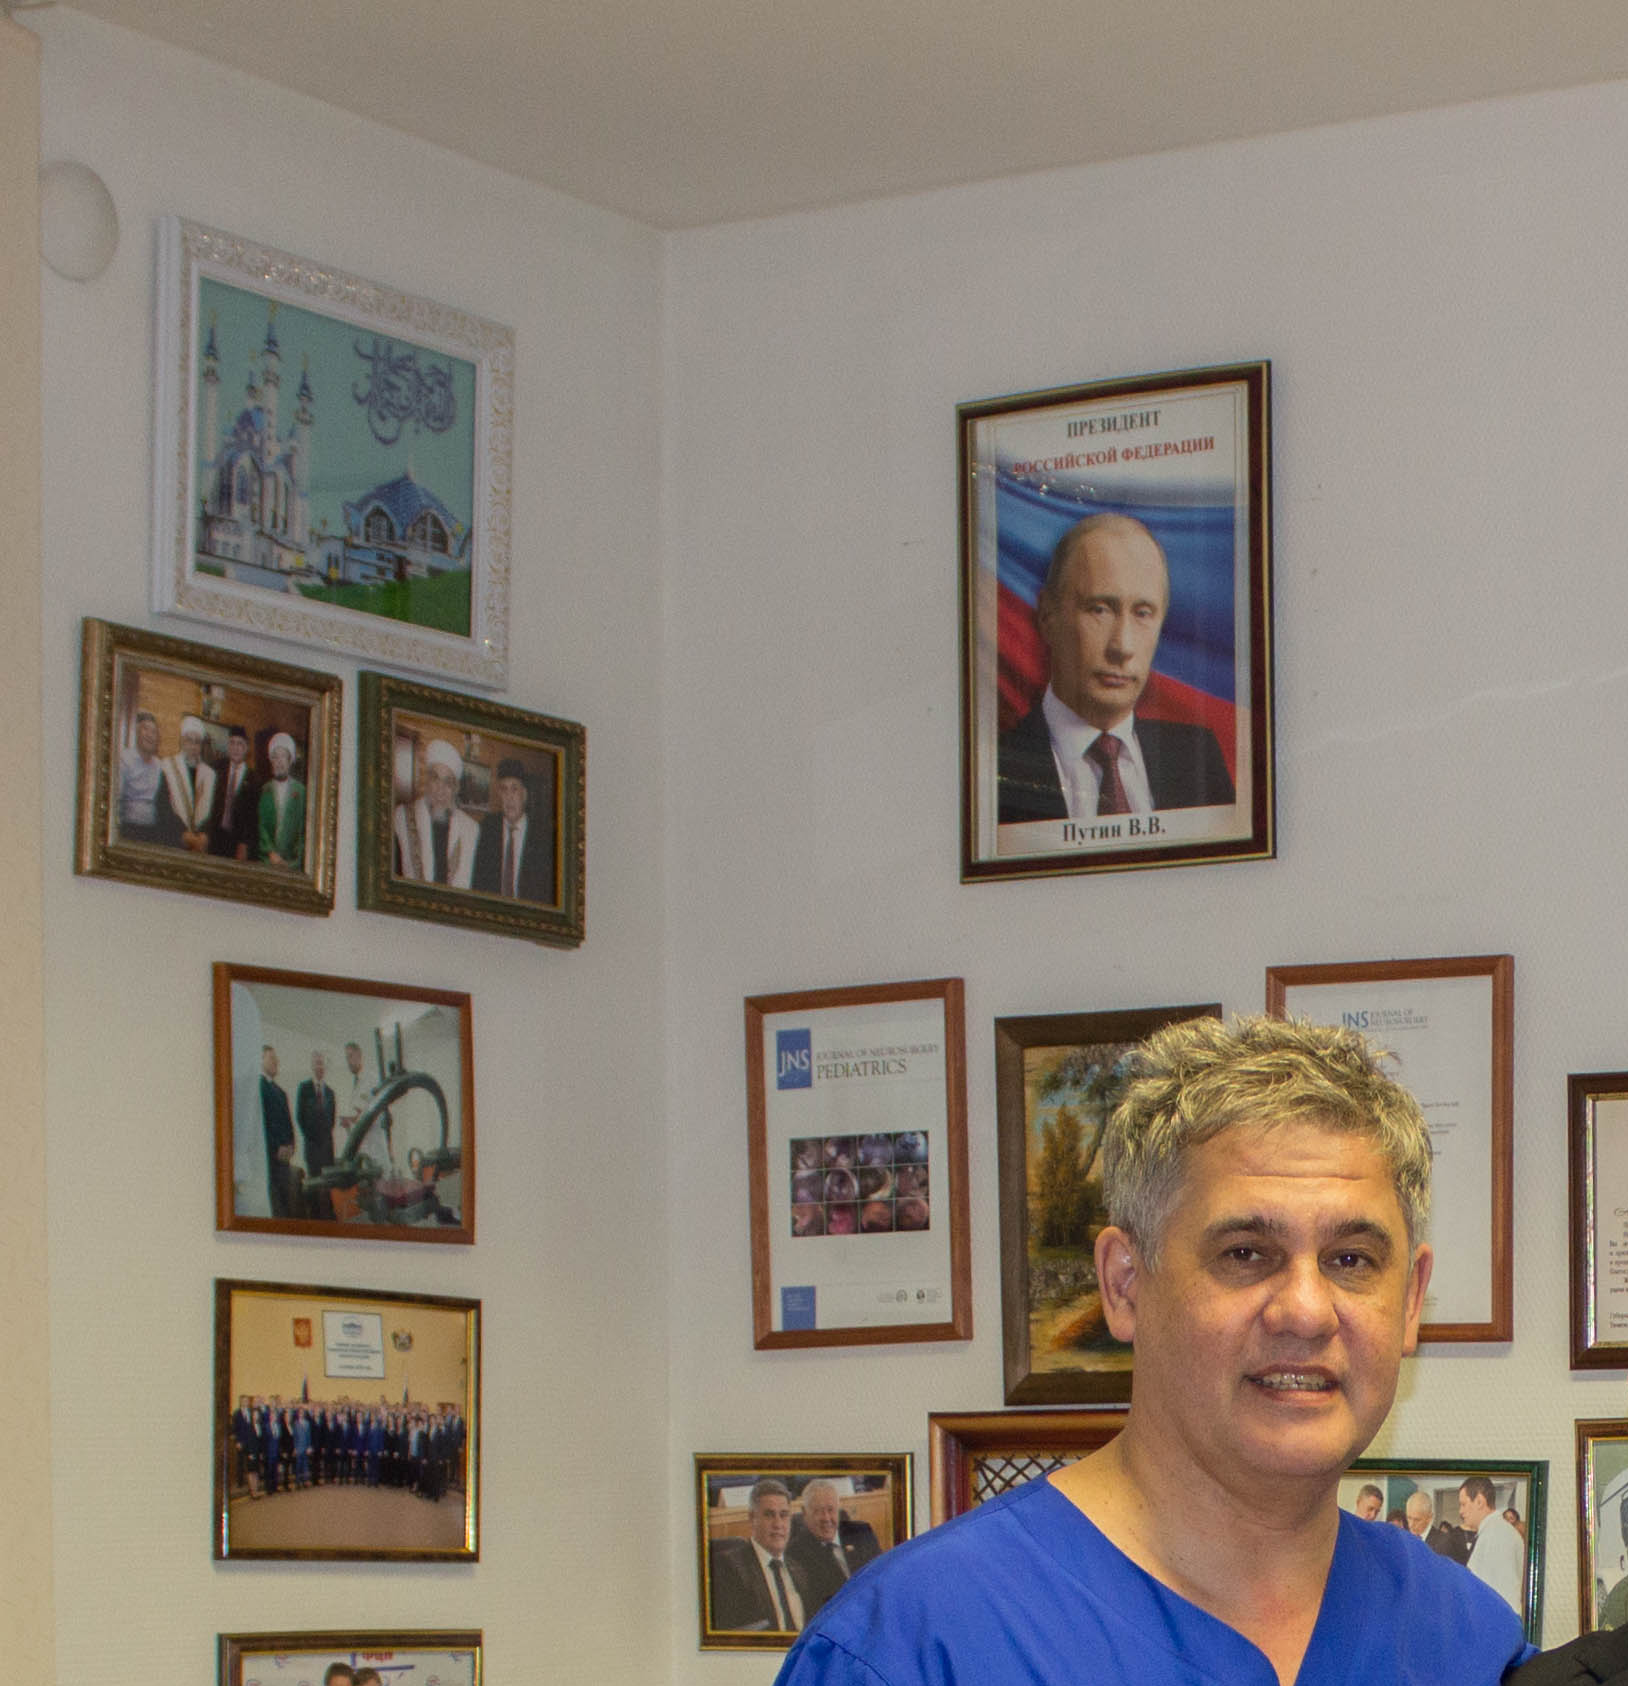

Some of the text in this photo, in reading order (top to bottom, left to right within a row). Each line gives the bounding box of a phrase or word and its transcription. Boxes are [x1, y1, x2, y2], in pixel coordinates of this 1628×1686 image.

[1067, 410, 1161, 438] ПРЕЗИДЕНТ
[1013, 436, 1215, 474] РОССИЙСКОЙ ФЕДЕРАЦИИ
[1063, 815, 1166, 846] Путин В.В.
[778, 1048, 811, 1078] JNS
[816, 1058, 907, 1080] PEDIATRICS
